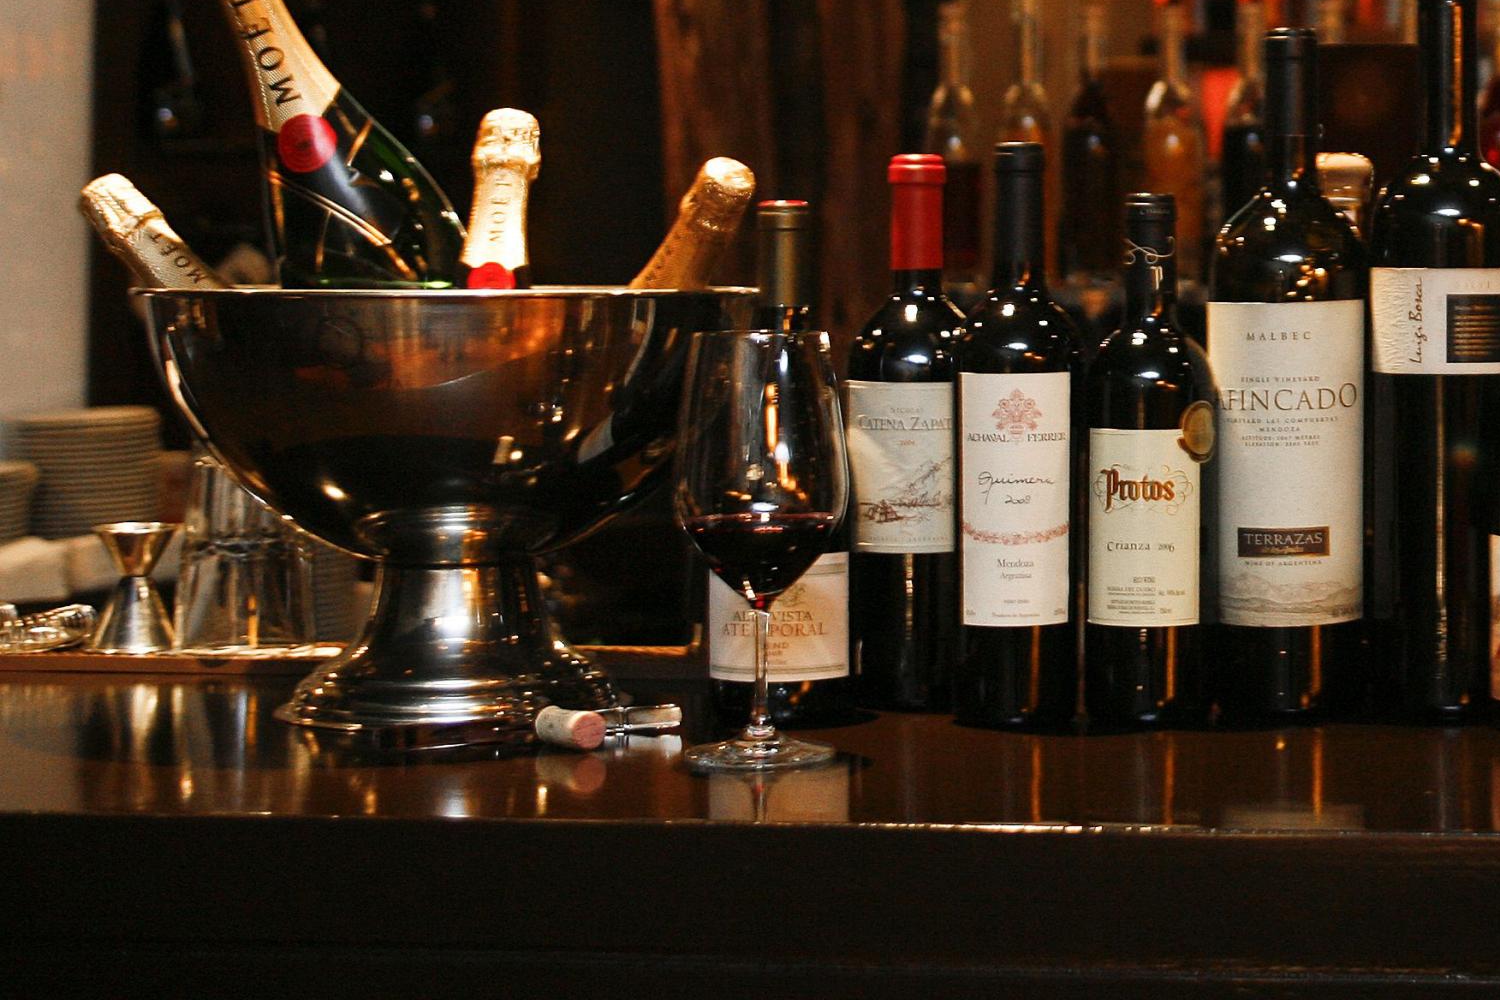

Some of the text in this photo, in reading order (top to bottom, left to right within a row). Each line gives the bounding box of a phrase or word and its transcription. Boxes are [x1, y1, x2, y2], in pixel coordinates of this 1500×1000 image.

[1246, 331, 1312, 341] MALBEC
[859, 415, 952, 431] CATENA ZAPAT
[1027, 432, 1067, 442] FERRER
[1100, 469, 1175, 514] Protos
[1243, 532, 1323, 545] TERRAZAS
[1107, 541, 1151, 551] Crianza
[997, 558, 1034, 568] Mendoza
[722, 621, 829, 638] ATEPORAL
